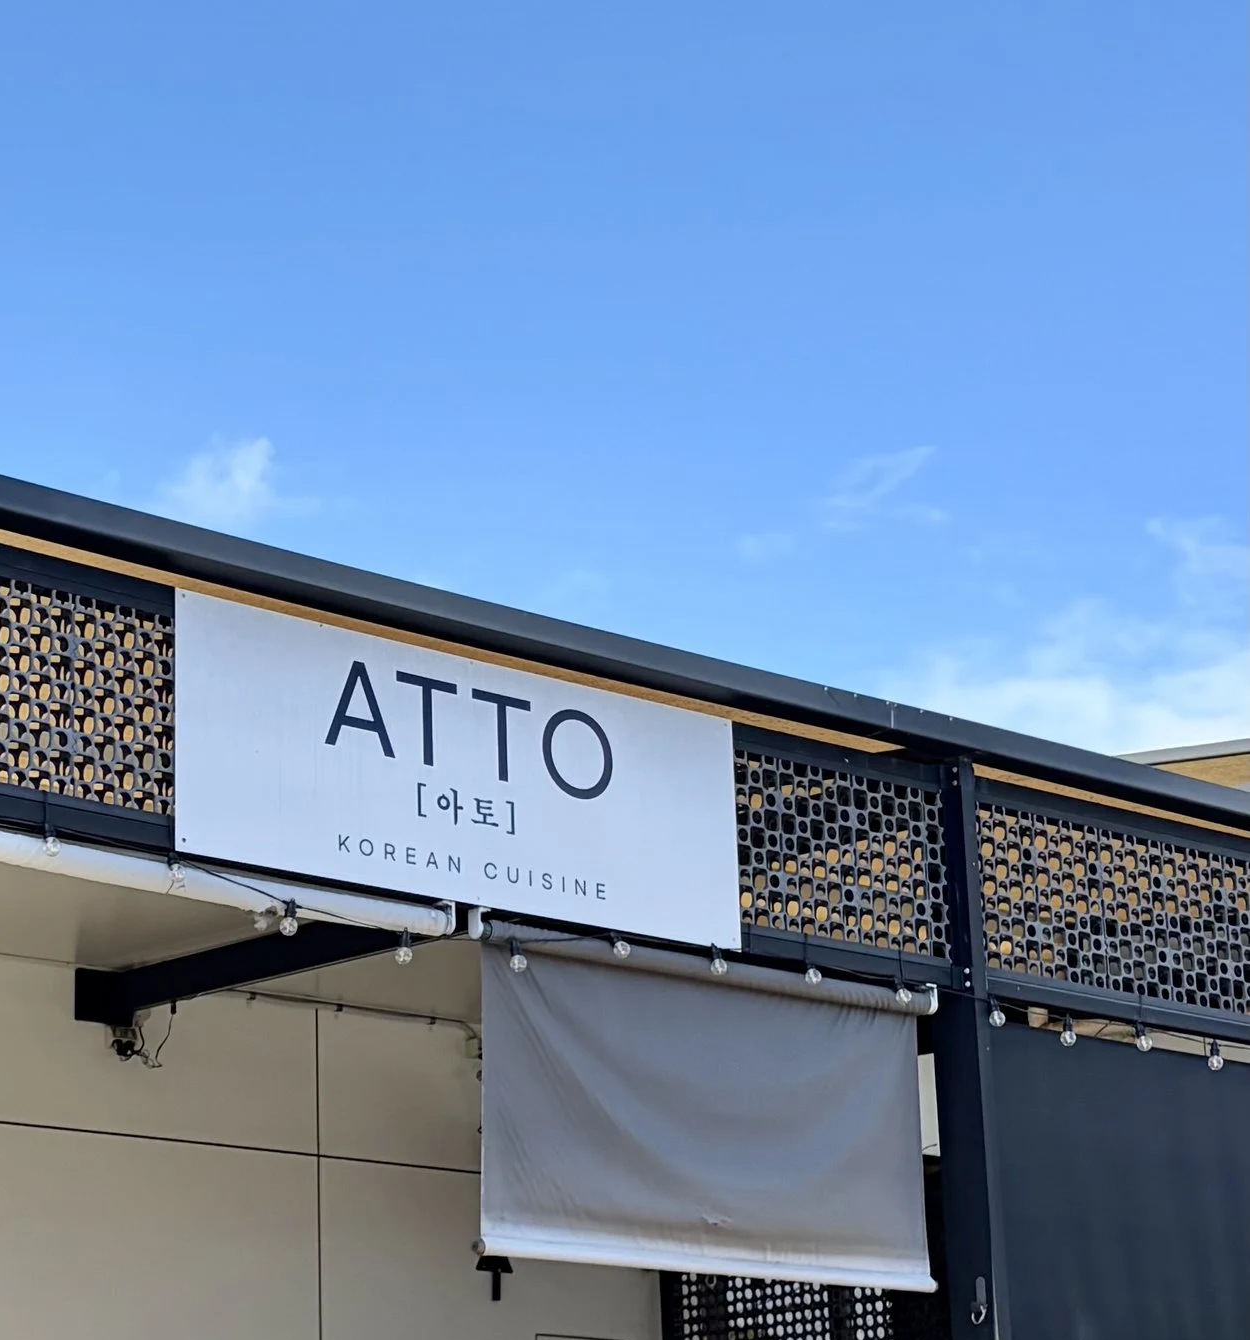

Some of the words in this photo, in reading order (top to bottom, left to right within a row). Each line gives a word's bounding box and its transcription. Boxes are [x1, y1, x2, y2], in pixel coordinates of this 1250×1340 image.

[324, 660, 614, 800] ATTO
[416, 782, 516, 836] [아토]
[337, 833, 462, 874] KOREAN
[483, 861, 608, 901] CUISINE
